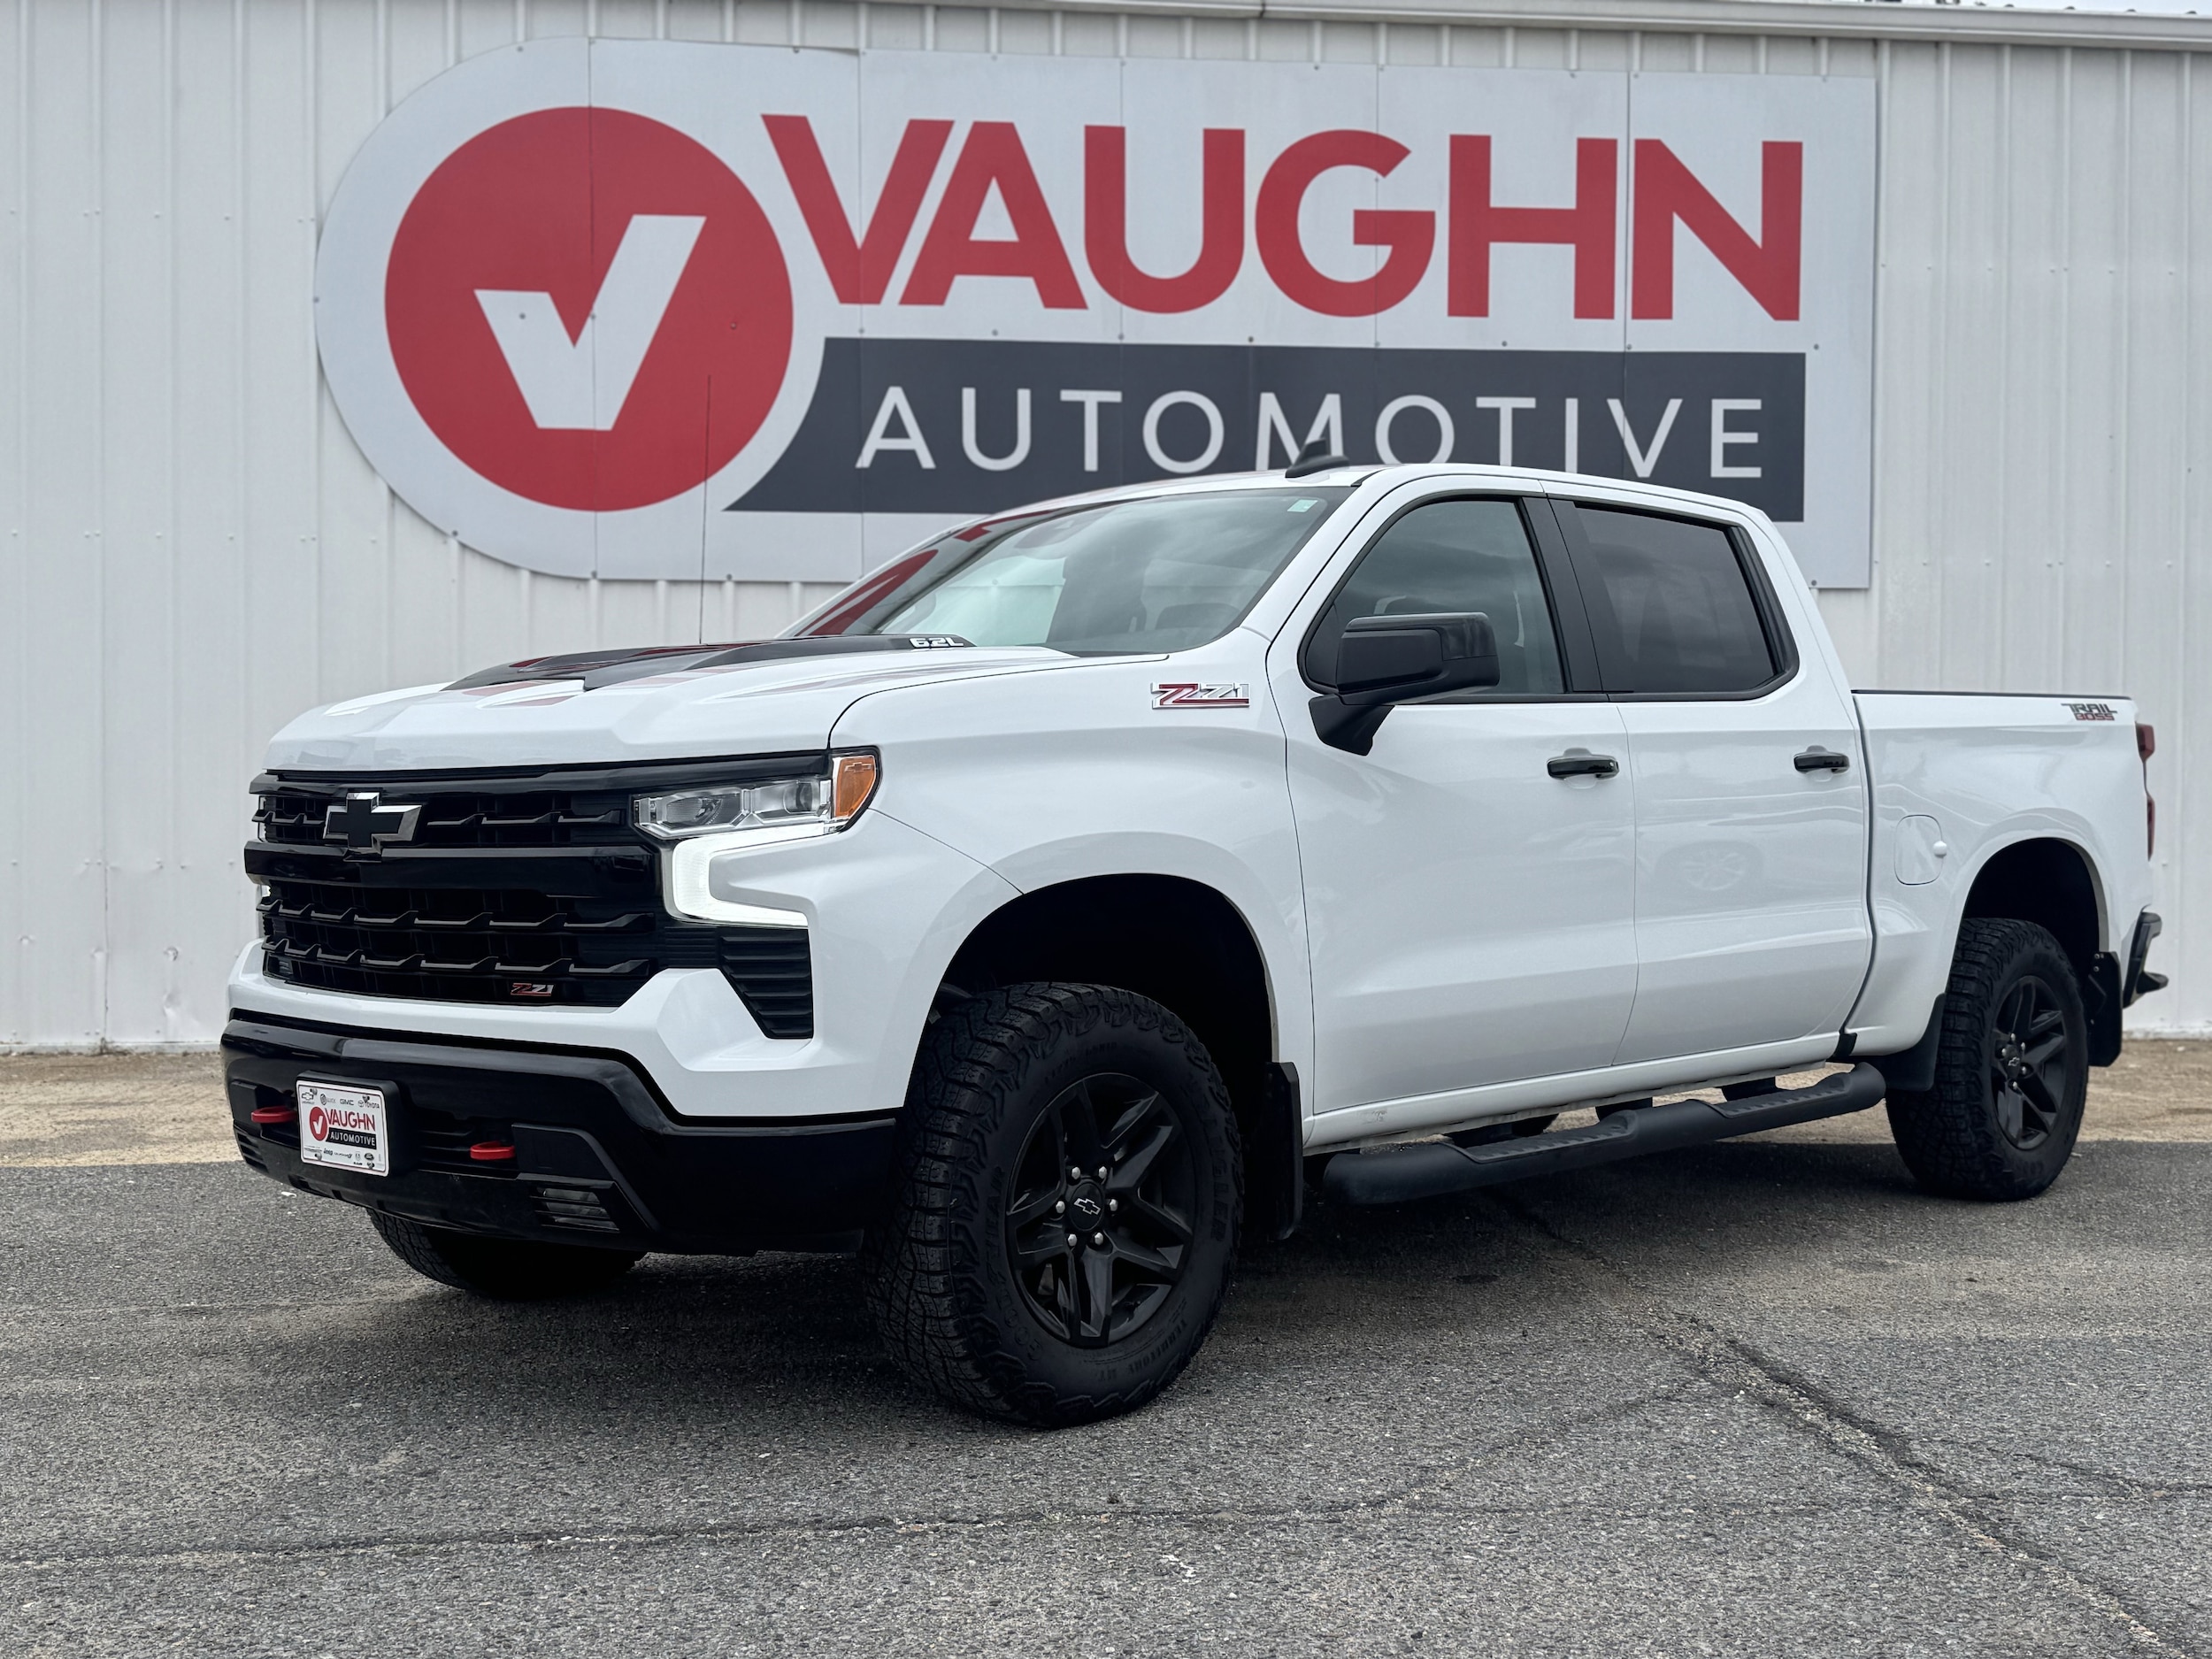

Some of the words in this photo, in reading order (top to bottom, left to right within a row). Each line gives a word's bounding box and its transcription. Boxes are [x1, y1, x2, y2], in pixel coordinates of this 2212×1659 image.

[763, 114, 1801, 320] VAUGHN
[855, 386, 1763, 480] AUTOMOTIVE
[1150, 682, 1249, 709] Z71
[2060, 703, 2118, 714] TRAIL
[2073, 712, 2116, 721] BOSS
[511, 982, 555, 996] Z71
[325, 1108, 376, 1132] VAUGHN
[330, 1131, 376, 1146] AUTOMOTIVE
